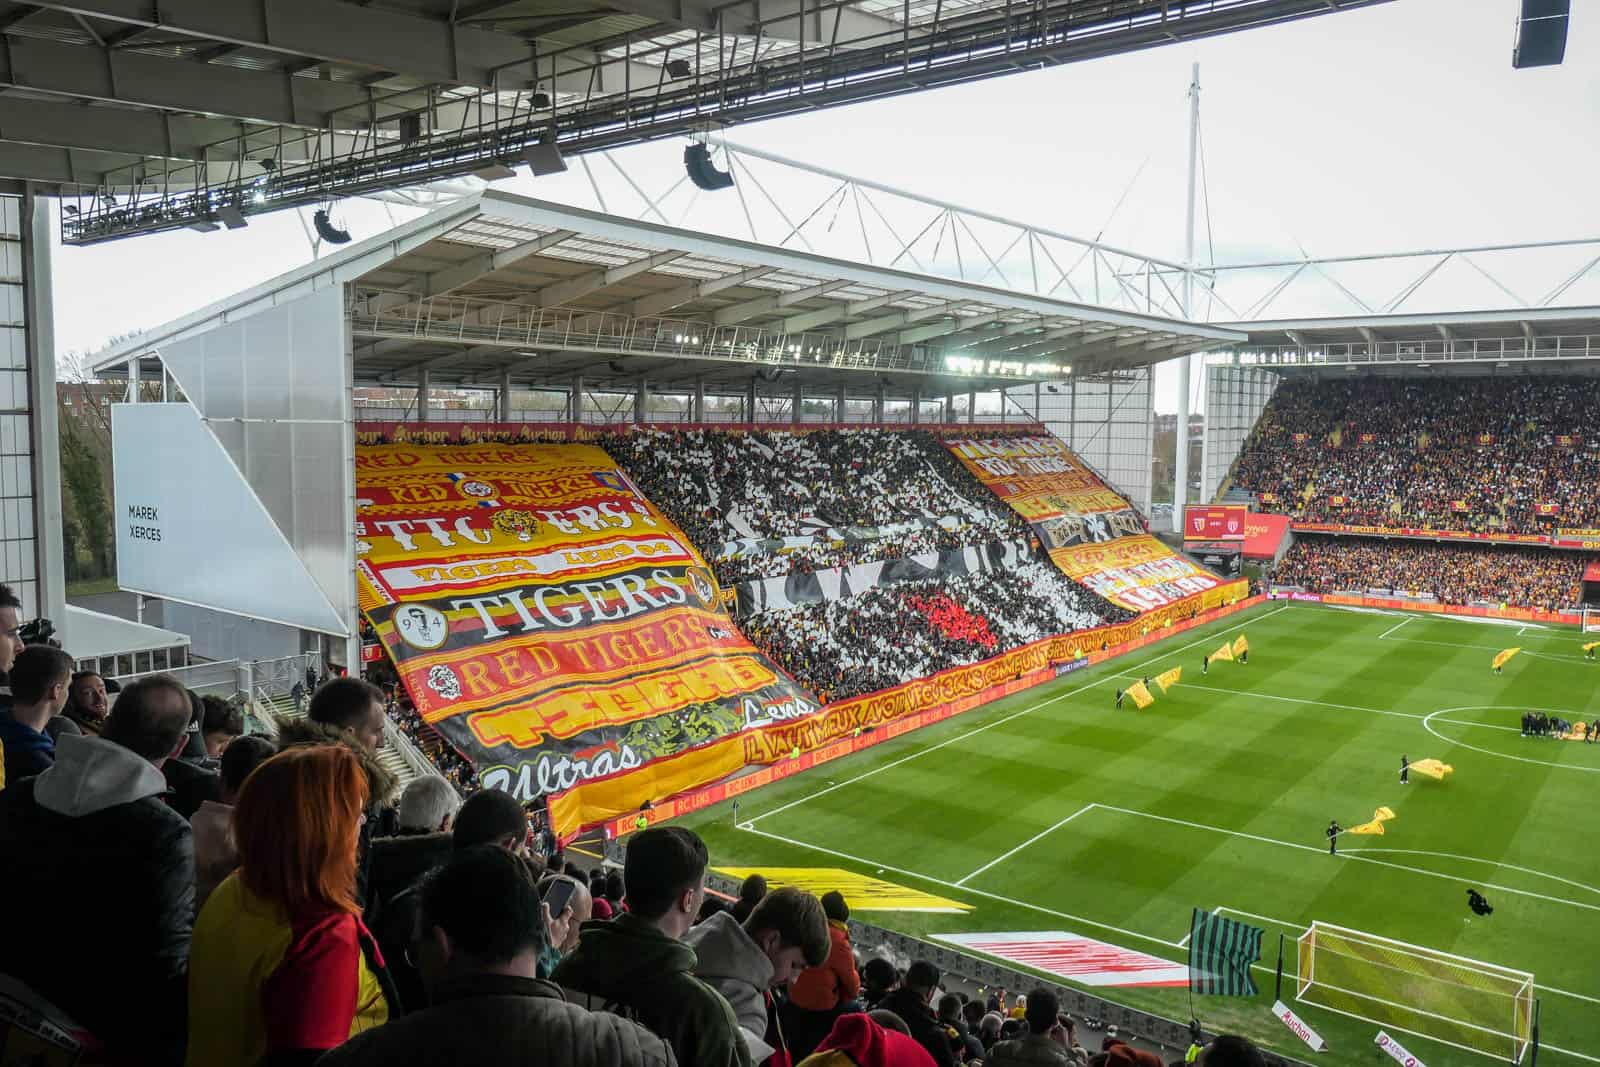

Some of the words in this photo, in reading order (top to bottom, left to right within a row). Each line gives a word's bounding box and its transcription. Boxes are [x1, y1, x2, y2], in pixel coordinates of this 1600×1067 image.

[388, 485, 448, 502] RED
[504, 475, 597, 499] TIGERS
[128, 505, 158, 520] MAREK
[129, 525, 161, 541] XERCES
[560, 543, 635, 566] LENS
[450, 569, 687, 639] TIGERS
[460, 645, 560, 696] RED
[566, 616, 708, 670] TIGERS
[742, 697, 813, 729] Lens
[744, 730, 764, 764] IL
[764, 725, 812, 759] VAUT
[483, 745, 642, 801] Ultras
[728, 781, 739, 793] RC
[740, 776, 757, 789] LENS
[678, 800, 690, 811] RC
[692, 792, 711, 807] LENS
[1280, 1010, 1311, 1042] Auchan
